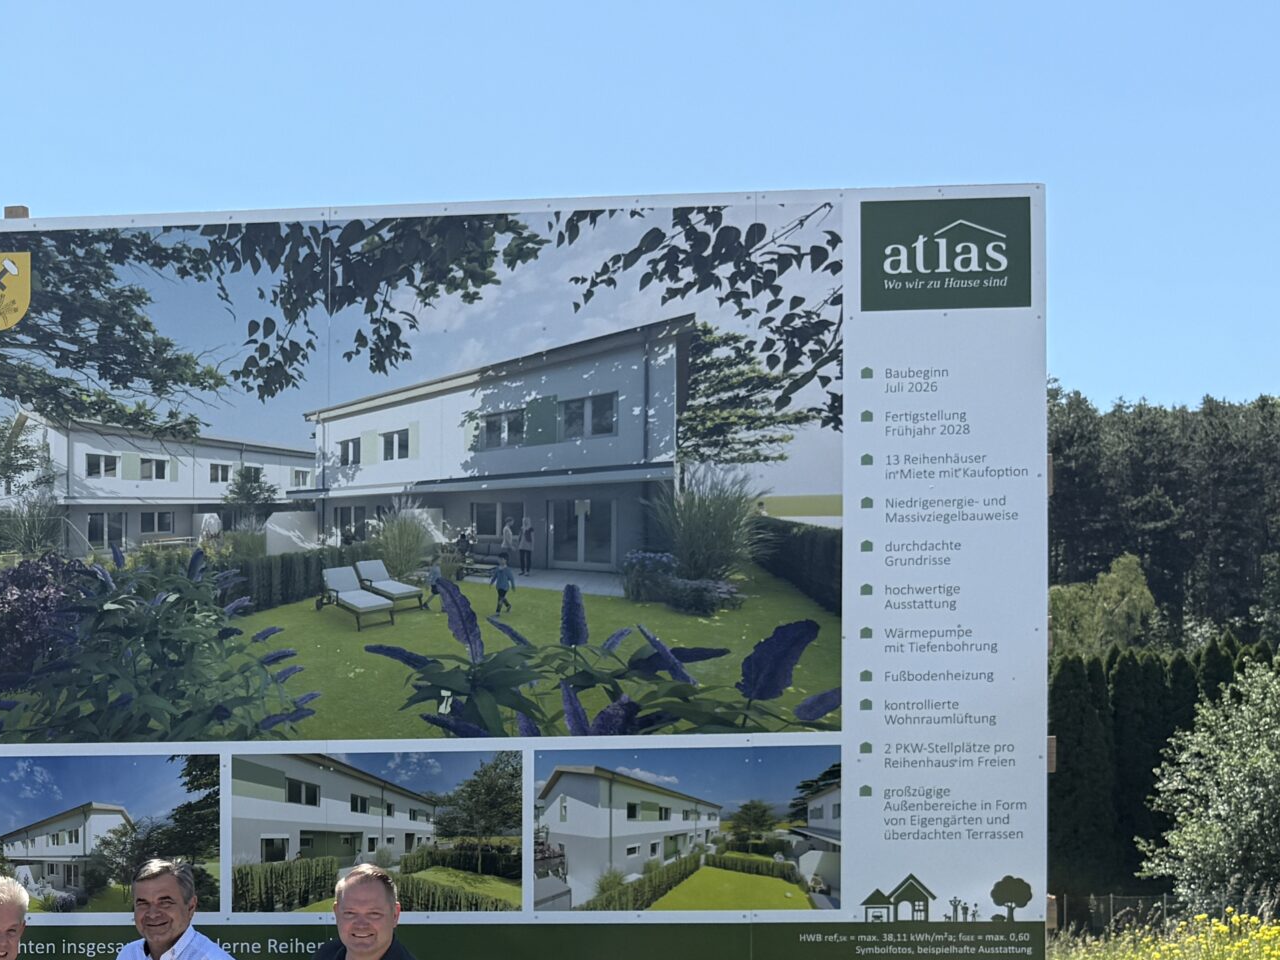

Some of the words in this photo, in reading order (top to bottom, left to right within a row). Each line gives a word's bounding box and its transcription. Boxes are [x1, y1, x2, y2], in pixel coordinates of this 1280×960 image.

[883, 234, 1008, 275] atlas
[883, 279, 902, 290] Wo
[905, 279, 925, 289] wir
[927, 280, 941, 289] zu
[943, 278, 980, 288] Hause
[982, 276, 1008, 287] sind
[885, 367, 949, 380] Baubeginn
[884, 382, 904, 394] Juli
[908, 381, 938, 393] 2026
[885, 409, 966, 424] Fertigstellung
[885, 424, 937, 438] Frühjahr
[940, 424, 971, 435] 2028
[885, 454, 900, 465] 13
[903, 453, 987, 465] Reihenhäuser
[885, 468, 896, 480] in
[899, 468, 935, 479] Miete
[939, 467, 960, 478] mit
[962, 466, 1029, 479] Kaufoption
[885, 496, 980, 510] Niedrigenergie-
[983, 495, 1007, 507] und
[885, 510, 1019, 524] Massivziegelbauweise
[885, 540, 962, 552] durchdachte
[885, 555, 951, 567] Grundrisse
[885, 584, 960, 596] hochwertige
[885, 598, 957, 611] Ausstattung
[885, 627, 972, 641] Wärmepumpe
[884, 642, 904, 653] mit
[908, 641, 998, 654] Tiefenbohrung
[885, 670, 994, 683] Fußbodenheizung
[884, 699, 959, 711] kontrollierte
[884, 713, 997, 727] Wohnraumlüftung
[884, 743, 892, 754] 2
[895, 742, 990, 756] PKW-Stellplätze
[994, 743, 1015, 755] pro
[884, 757, 955, 769] Reihenhaus
[958, 757, 974, 767] im
[978, 756, 1016, 767] Freien
[883, 786, 951, 799] großzügige
[883, 800, 977, 812] Außenbereiche
[981, 799, 992, 811] in
[996, 799, 1028, 811] Form
[884, 816, 906, 826] von
[910, 814, 982, 828] Eigengärten
[986, 814, 1010, 825] und
[884, 829, 962, 841] überdachten
[965, 828, 1024, 840] Terrassen
[799, 933, 822, 942] HWB
[857, 934, 880, 942] max.
[882, 933, 908, 943] 38,11
[1009, 932, 1030, 943] 0,60
[62, 939, 125, 958] insgesa
[855, 945, 915, 956] Symbolfotos,
[917, 945, 976, 956] beispielhafte
[978, 945, 1033, 956] Ausstattung
